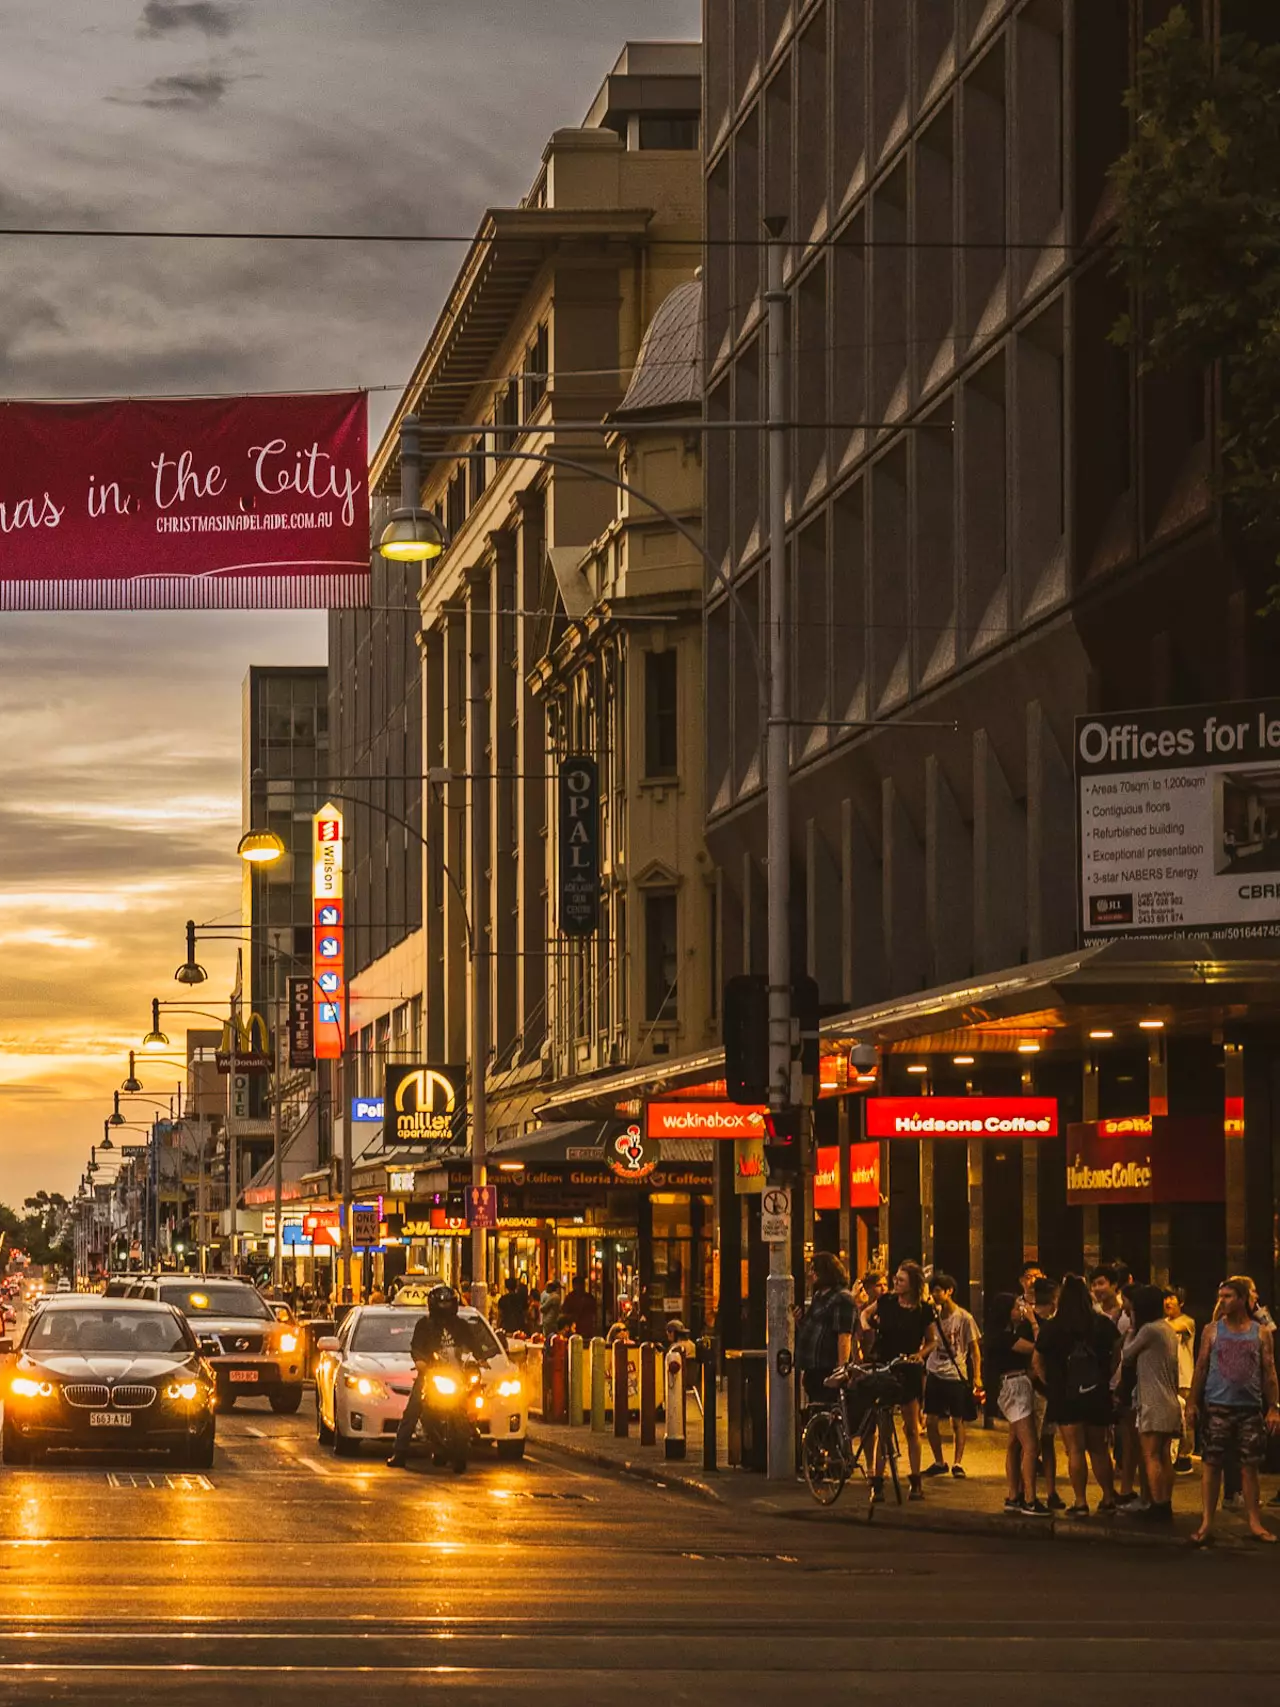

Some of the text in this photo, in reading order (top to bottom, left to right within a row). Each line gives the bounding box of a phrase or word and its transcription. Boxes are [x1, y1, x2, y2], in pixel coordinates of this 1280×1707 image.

[87, 475, 132, 517] in
[151, 450, 227, 510] the
[248, 439, 362, 527] City
[156, 511, 333, 534] CHRISTMASINADELAIDE.COM.AU
[1079, 722, 1195, 764] Offices
[1203, 716, 1250, 753] for
[1091, 784, 1118, 796] Areas
[1153, 781, 1161, 791] to
[567, 770, 591, 868] OPAL
[1092, 801, 1171, 819] Contiguous floors
[1092, 822, 1185, 840] Refurbished building
[1093, 843, 1204, 862] Exceptional presentation
[323, 845, 335, 891] Wilson
[1093, 866, 1199, 883] 3-star NABERS Energy
[295, 983, 309, 1049] POLITES
[235, 1076, 246, 1117] OTE
[357, 1102, 384, 1118] Poli
[397, 1112, 452, 1130] miller
[663, 1112, 745, 1129] wokinabox
[895, 1114, 1051, 1132] Hudsons Coffee
[397, 1129, 453, 1140] apartments
[571, 1172, 611, 1185] Gloria
[668, 1173, 713, 1186] Coffees
[1067, 1161, 1151, 1190] Hudsons Coffee
[356, 1213, 376, 1224] ONE
[356, 1224, 377, 1233] WAY
[404, 1290, 430, 1299] TAX
